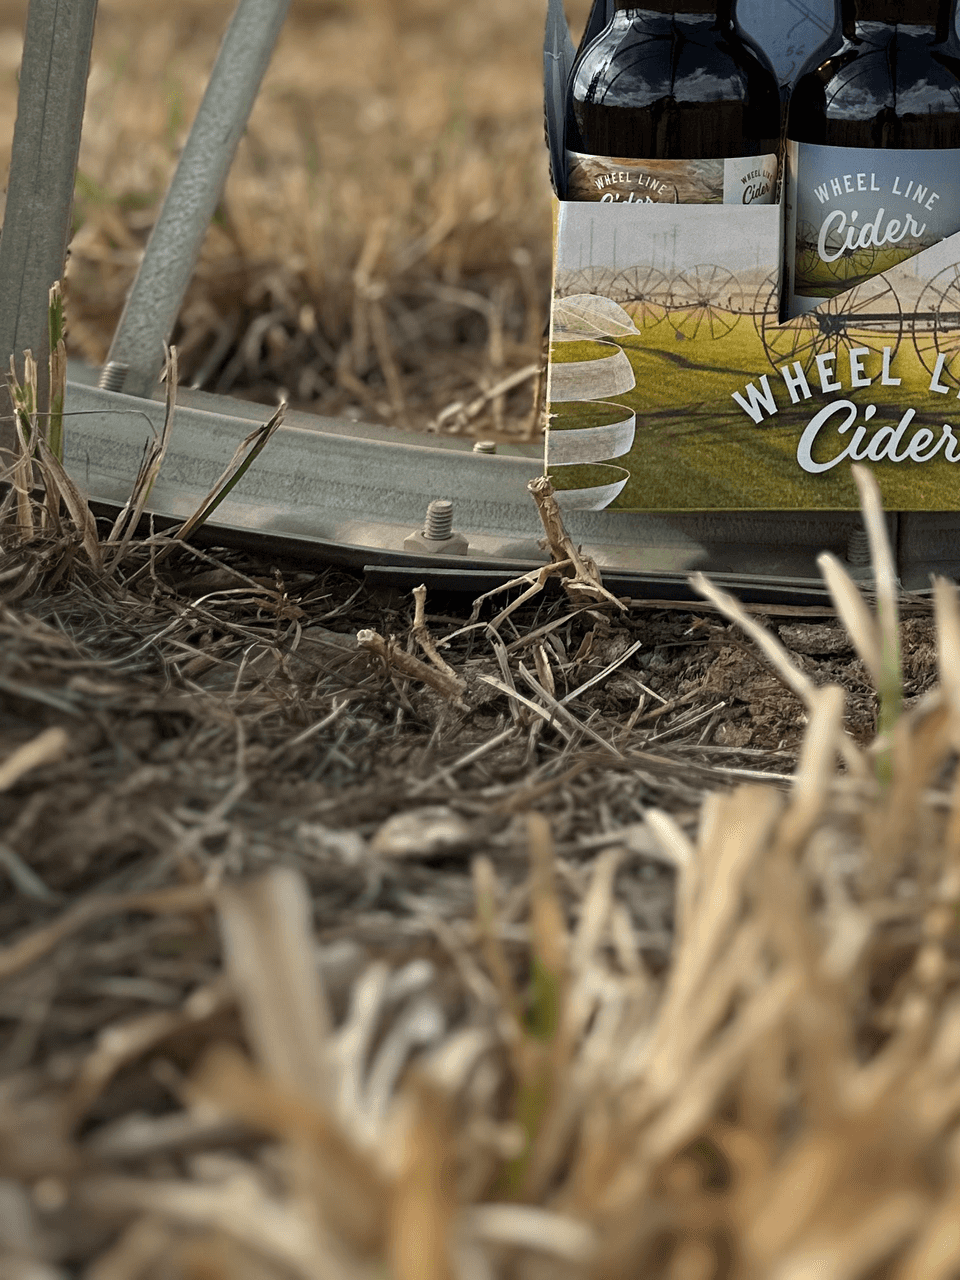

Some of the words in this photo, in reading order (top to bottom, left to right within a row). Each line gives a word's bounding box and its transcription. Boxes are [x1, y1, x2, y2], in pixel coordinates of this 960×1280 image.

[594, 171, 632, 190] WHEEL
[638, 173, 668, 195] LINE
[741, 170, 761, 185] WHEEL
[742, 182, 769, 204] Cider
[814, 172, 880, 204] WHEEL
[891, 176, 940, 211] LINE
[817, 207, 927, 263] Cider
[731, 346, 902, 425] WHEEL
